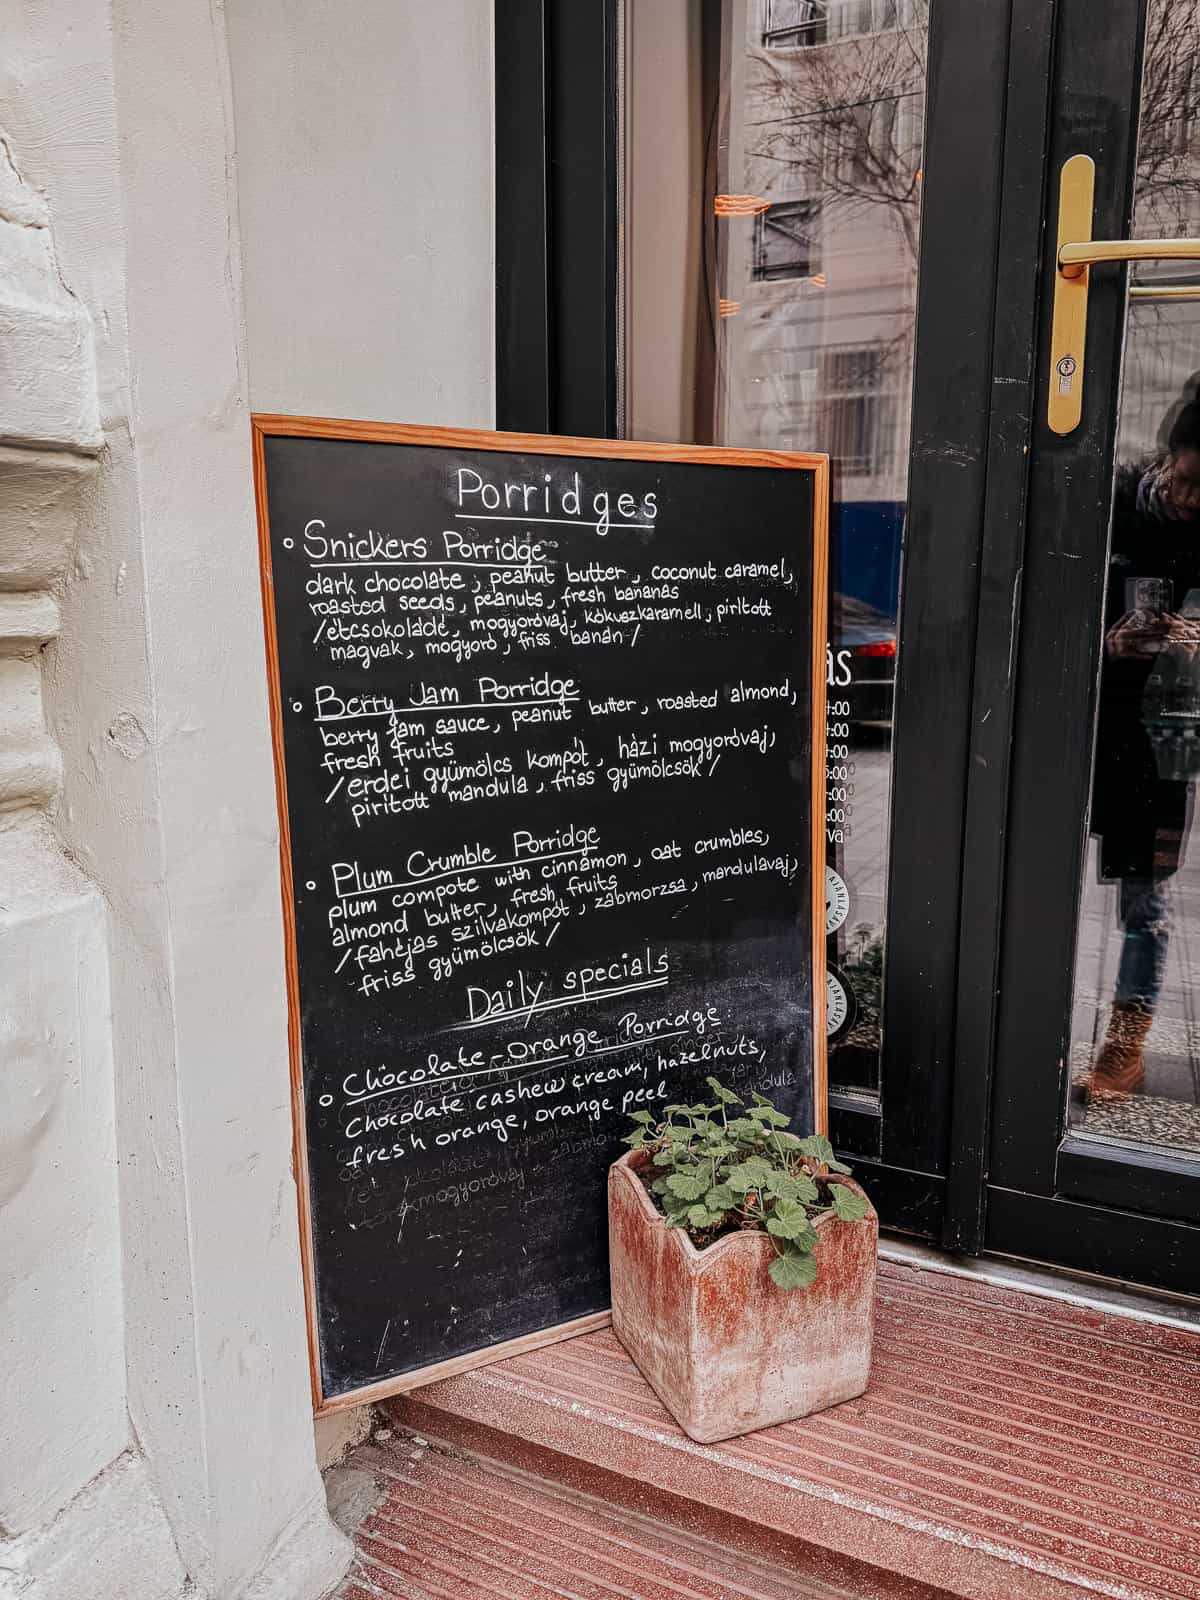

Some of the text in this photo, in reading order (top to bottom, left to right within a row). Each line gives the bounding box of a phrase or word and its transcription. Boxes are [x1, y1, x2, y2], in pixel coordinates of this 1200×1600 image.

[458, 468, 657, 535] Porridges
[304, 519, 547, 569] Snickers Porridge
[305, 572, 356, 595] dark
[489, 567, 555, 593] peanut
[651, 561, 717, 580] coconut
[309, 596, 386, 616] roasted
[561, 586, 605, 606] fresh
[615, 584, 679, 600] bananas
[518, 632, 551, 651] friss
[314, 672, 580, 726] Berry Jam Porridge
[320, 727, 379, 753] berry
[386, 722, 425, 749] jam
[512, 704, 572, 731] peanut
[656, 689, 718, 710] roasted
[320, 737, 454, 774] fresh fruits
[424, 753, 513, 794] gyümölcs
[551, 768, 596, 791] friss
[329, 899, 377, 928] plum
[392, 877, 479, 907] compote
[495, 867, 531, 888] with
[651, 840, 682, 860] oat
[332, 824, 600, 897] Plum Crumble Porridge
[332, 911, 409, 947] almond
[511, 881, 555, 908] fresh
[566, 872, 618, 897] fruits
[357, 969, 416, 997] friss
[467, 947, 669, 1028] Daily specials
[618, 1007, 721, 1036] Porridge
[345, 1095, 464, 1138] Chocolate
[476, 1079, 566, 1110] cashew
[345, 1134, 426, 1168] fresh
[535, 1098, 613, 1121] orange
[622, 1081, 668, 1112] peel
